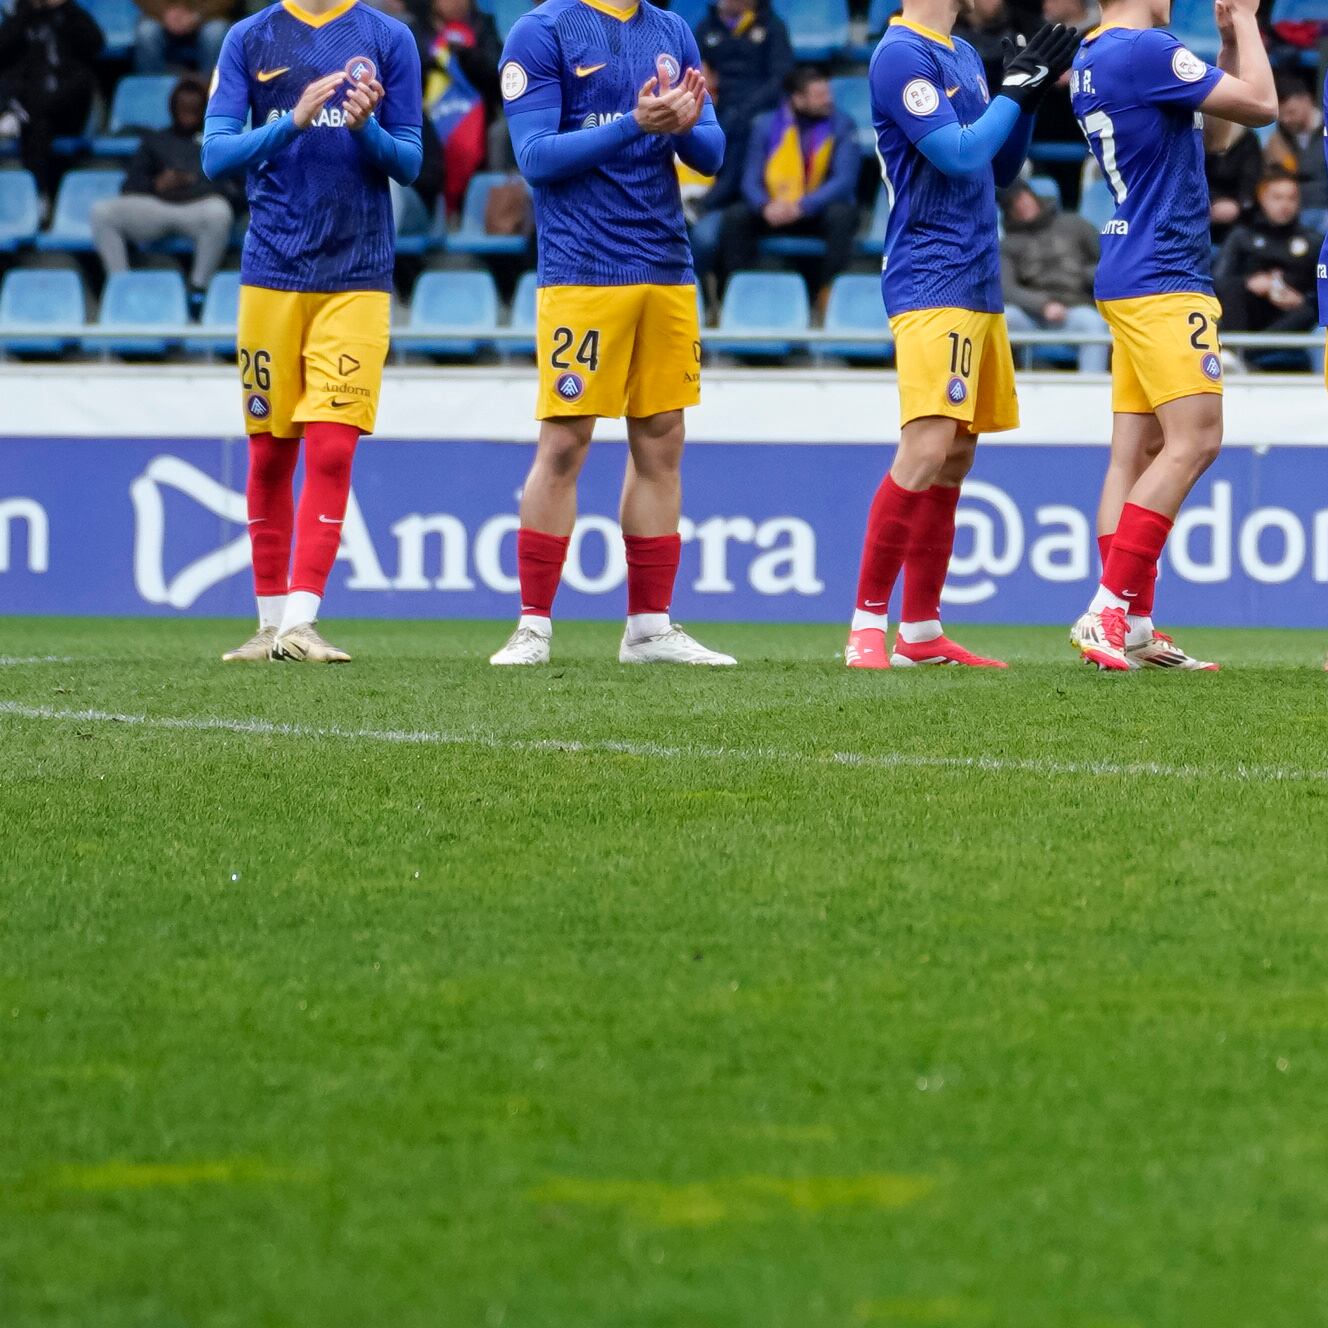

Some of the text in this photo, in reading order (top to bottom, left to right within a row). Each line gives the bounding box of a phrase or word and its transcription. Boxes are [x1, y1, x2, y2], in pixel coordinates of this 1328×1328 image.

[551, 327, 599, 372] 24
[1188, 311, 1213, 350] 2
[239, 348, 272, 392] 26
[948, 332, 972, 378] 10
[322, 381, 371, 398] Andorra
